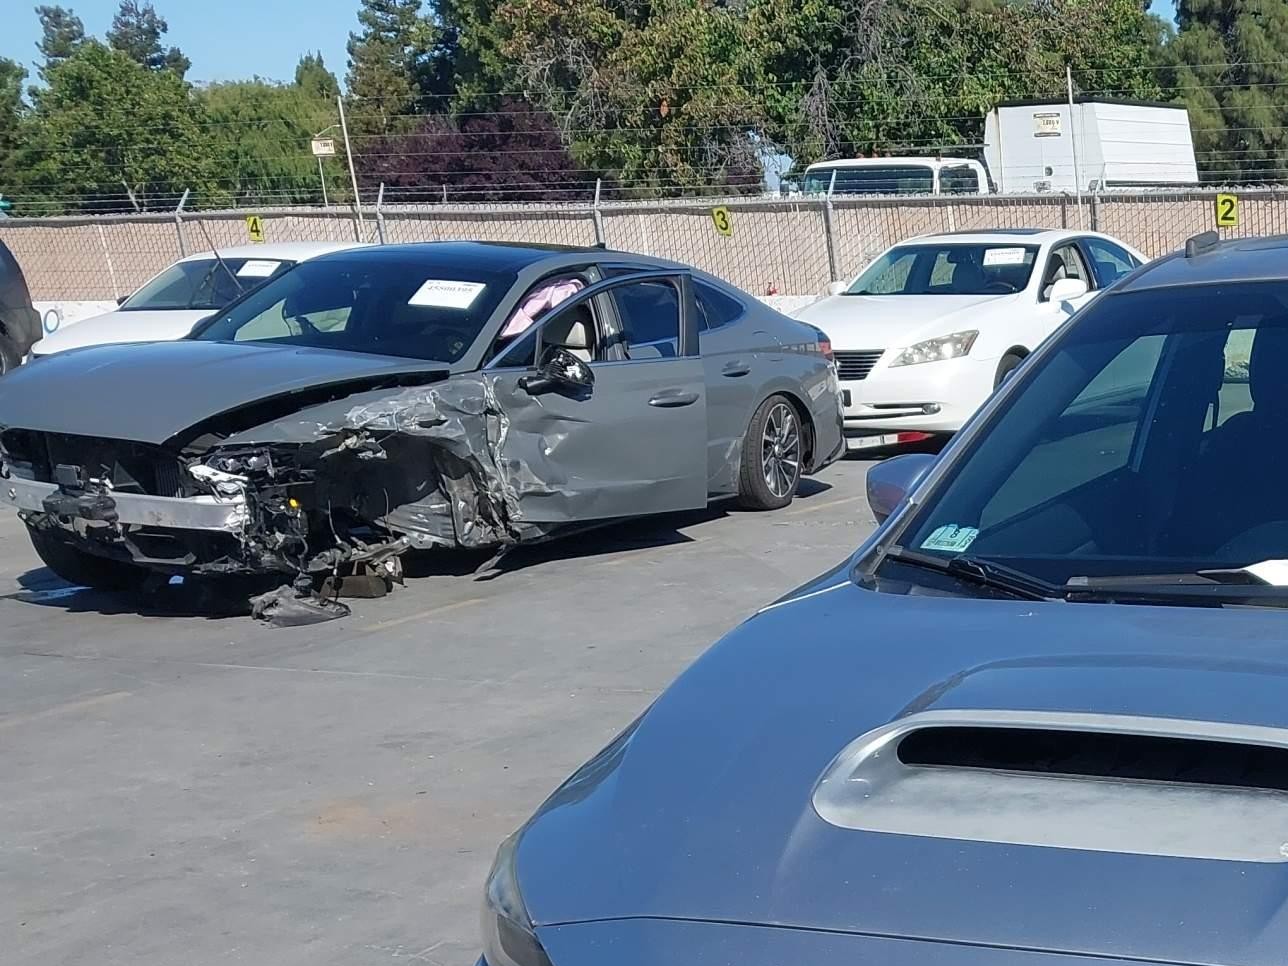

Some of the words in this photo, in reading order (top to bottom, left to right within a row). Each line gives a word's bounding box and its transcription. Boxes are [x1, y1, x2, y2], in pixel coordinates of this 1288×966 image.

[1220, 198, 1235, 221] 2
[250, 217, 260, 237] 4
[716, 210, 729, 231] 3
